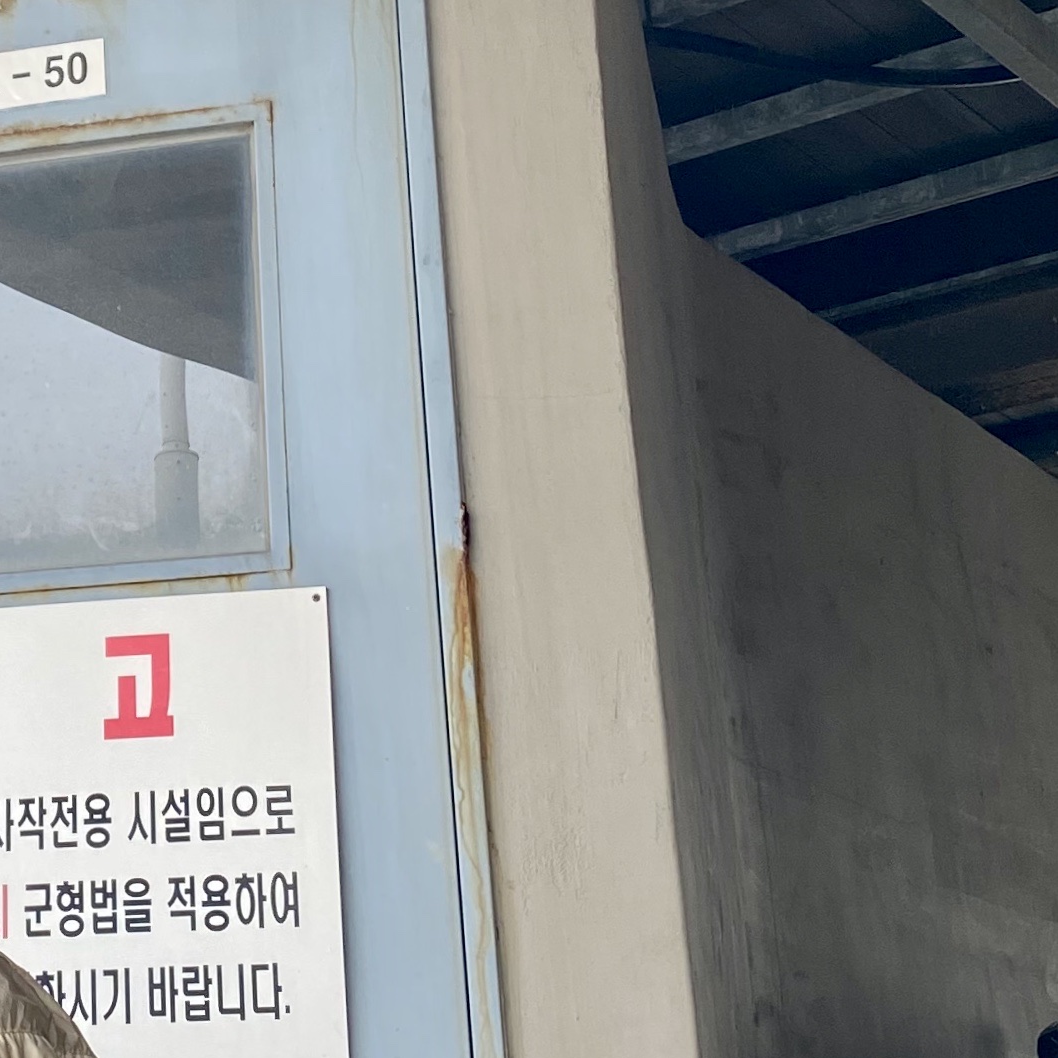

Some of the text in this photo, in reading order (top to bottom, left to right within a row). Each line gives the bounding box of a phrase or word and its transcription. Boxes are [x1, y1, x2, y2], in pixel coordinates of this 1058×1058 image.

[127, 784, 296, 845] 시설임으로
[24, 877, 152, 938] 군형법을
[167, 871, 301, 932] 적용하여
[147, 962, 291, 1023] 바랍니다.
